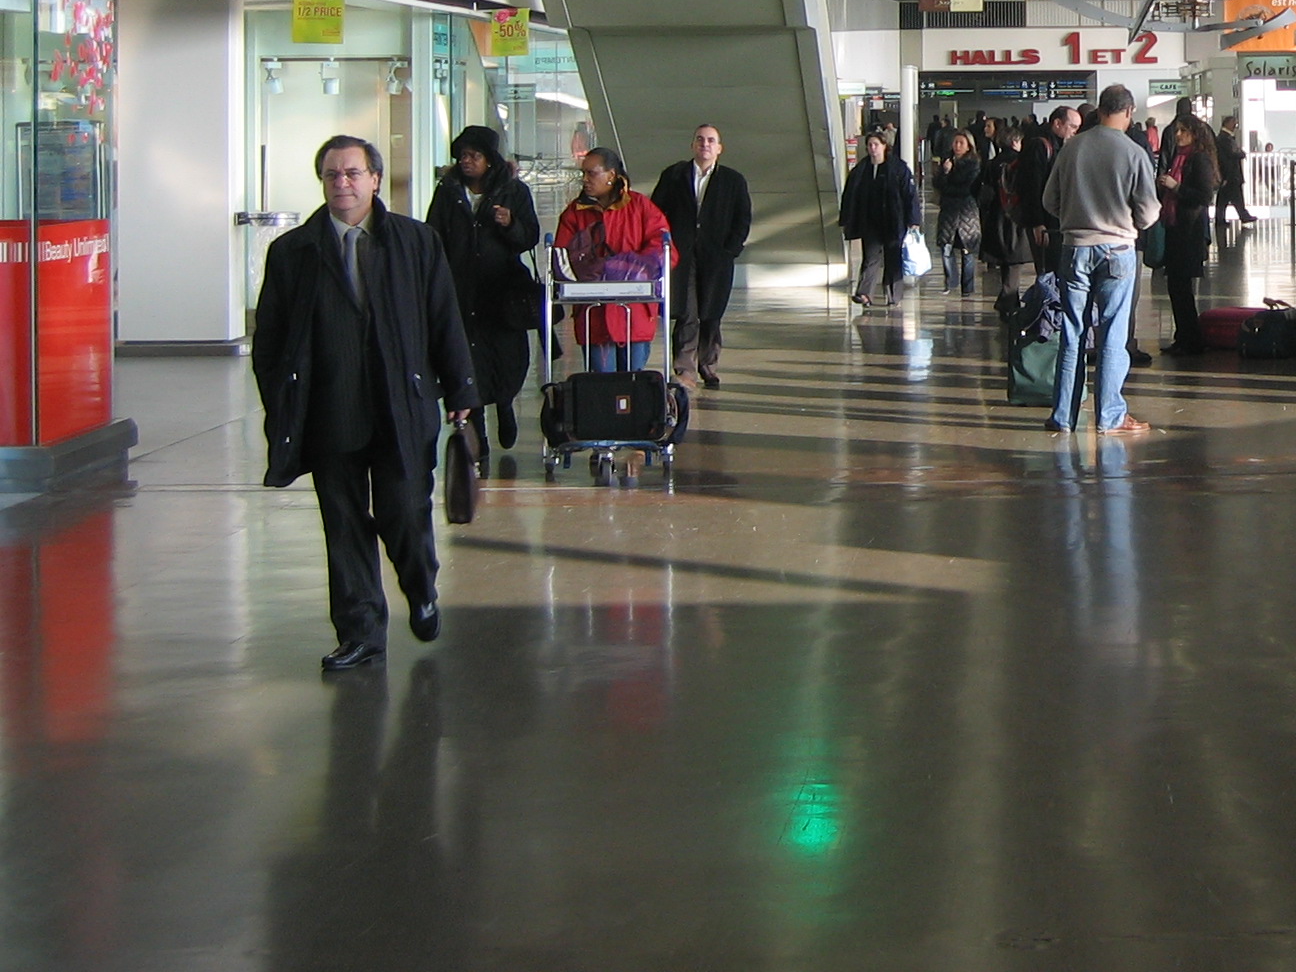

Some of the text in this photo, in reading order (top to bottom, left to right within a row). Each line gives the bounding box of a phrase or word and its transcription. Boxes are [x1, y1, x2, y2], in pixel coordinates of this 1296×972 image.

[313, 6, 342, 17] PRICE
[950, 31, 1159, 66] HALLS 1 ET 2
[1246, 58, 1296, 77] Solaris
[45, 240, 72, 263] Beauty
